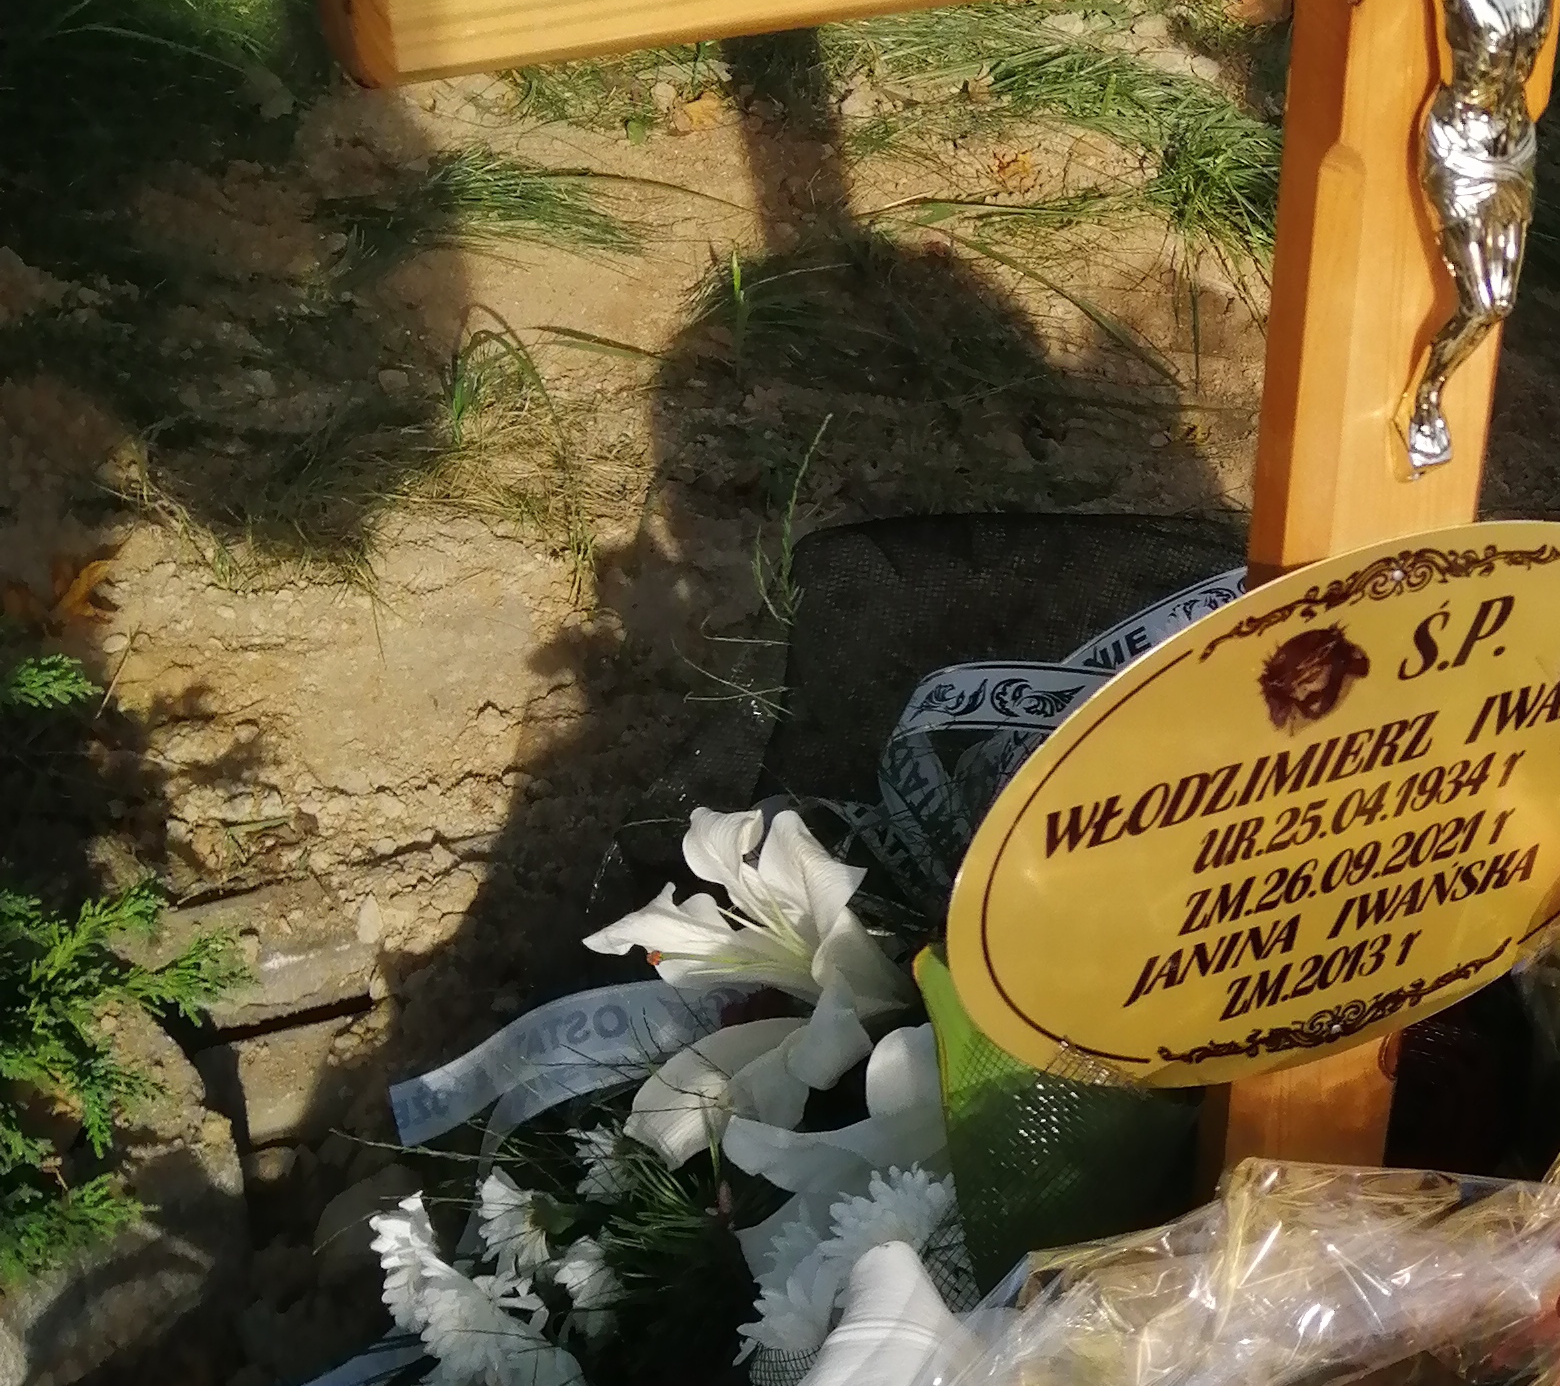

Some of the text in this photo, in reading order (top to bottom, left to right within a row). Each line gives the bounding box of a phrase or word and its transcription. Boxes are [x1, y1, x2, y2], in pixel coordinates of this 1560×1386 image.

[1397, 596, 1515, 681] Ś.P.
[1045, 710, 1440, 859] WŁODZIMIERZ
[1123, 843, 1541, 1008] JANINA IWAŃSKA
[1219, 932, 1391, 1023] ZM.2013
